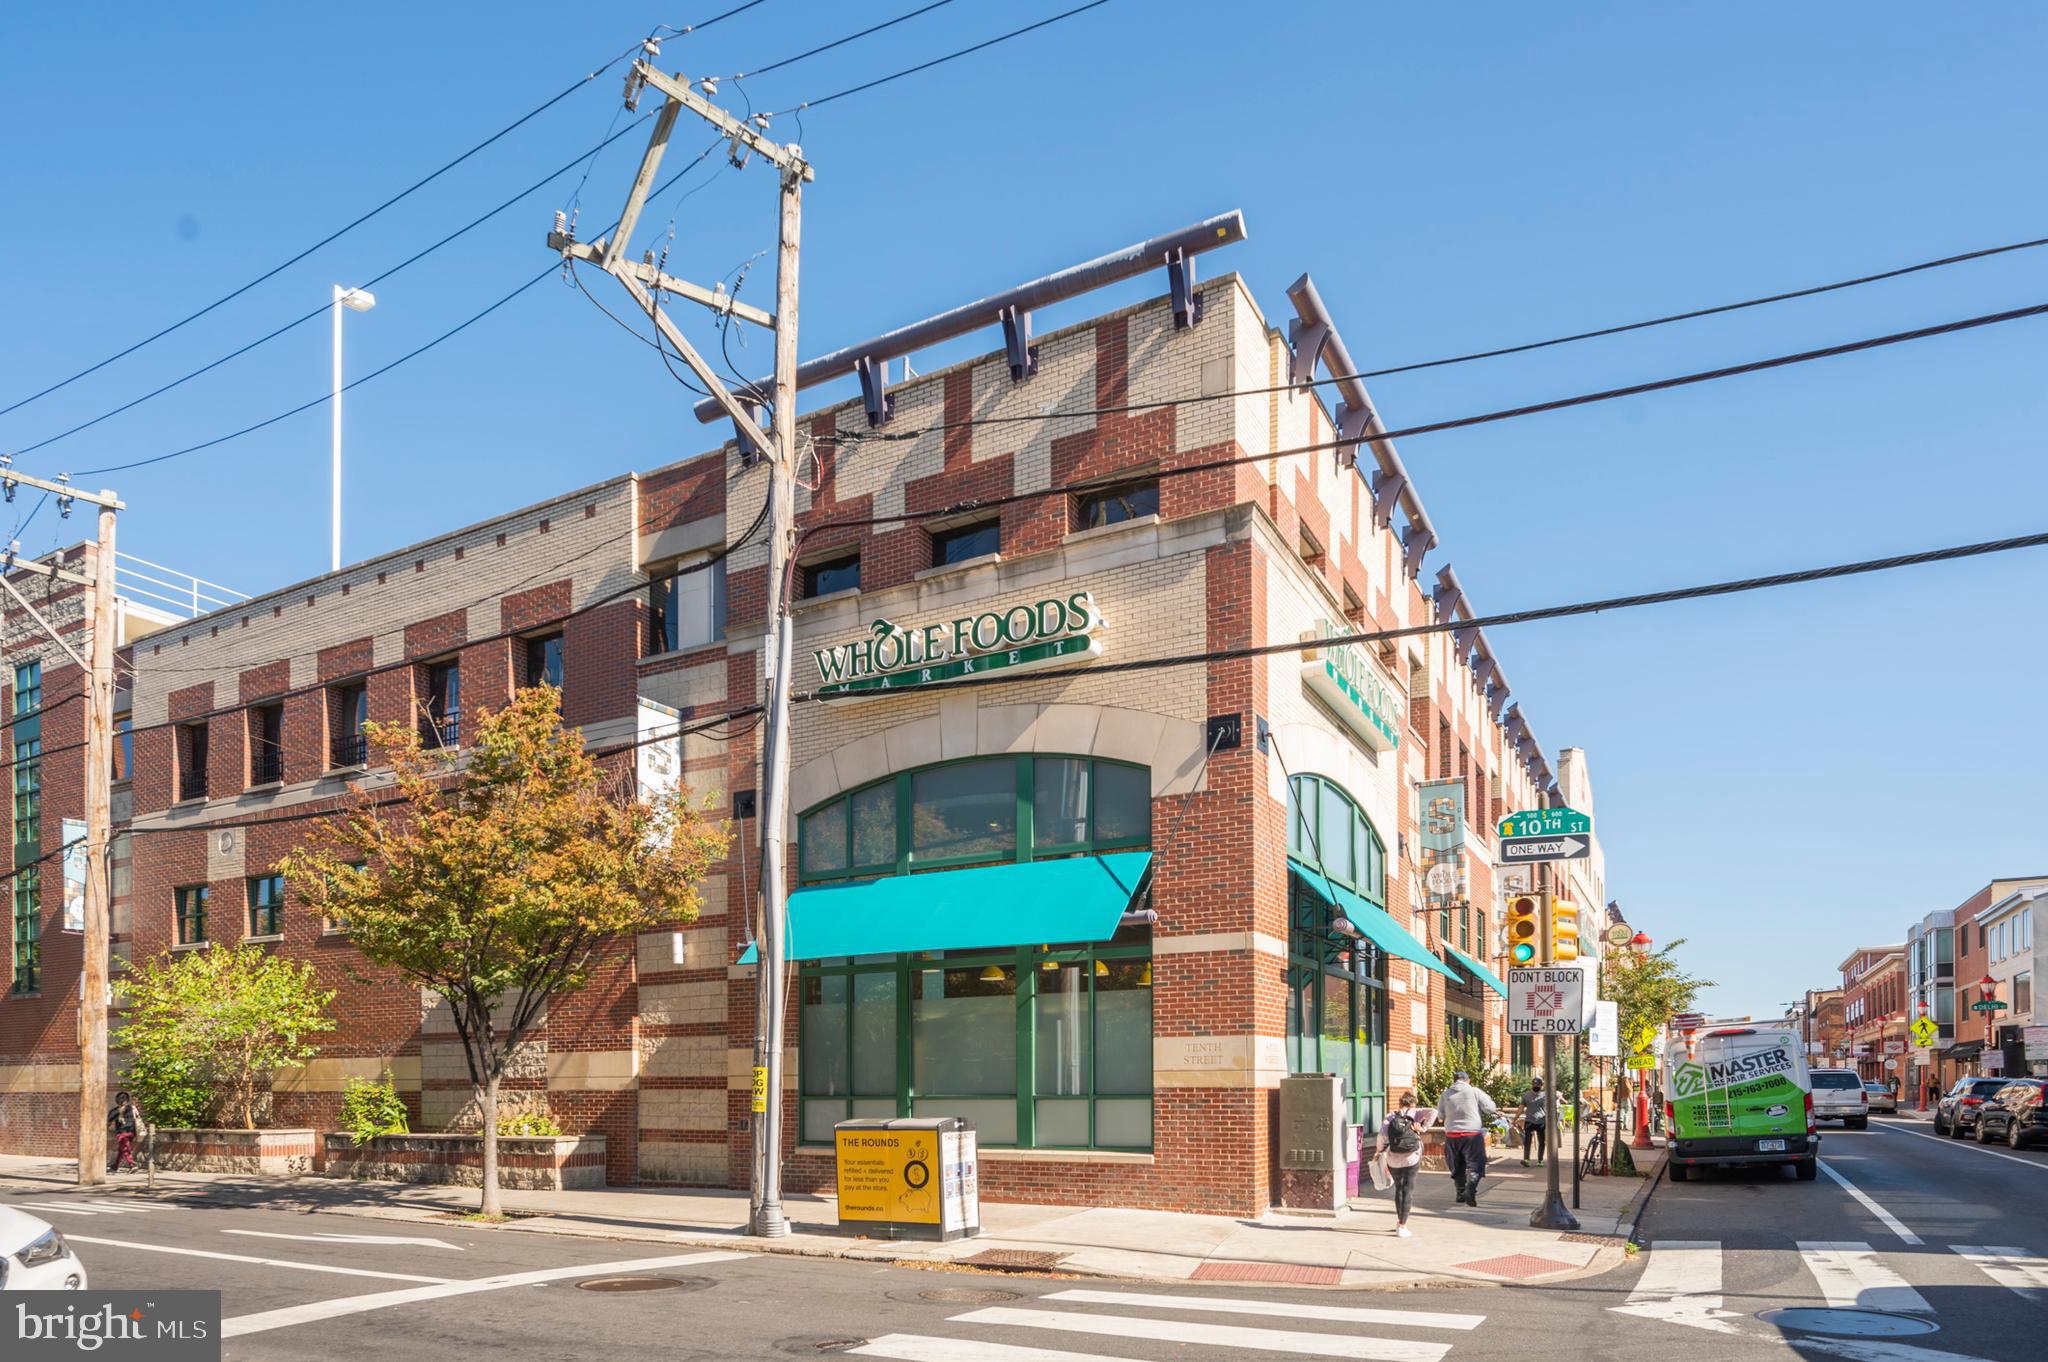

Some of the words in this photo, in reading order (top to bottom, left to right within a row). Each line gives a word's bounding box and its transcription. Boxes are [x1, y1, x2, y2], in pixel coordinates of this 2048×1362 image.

[812, 618, 949, 683] WHOLE
[951, 592, 1094, 656] FOODS
[1428, 798, 1455, 835] S
[1519, 818, 1562, 835] 10TH
[1570, 821, 1584, 833] ST
[1510, 845, 1534, 855] ONE
[1537, 843, 1563, 853] WAY
[1511, 971, 1541, 983] DONT
[1544, 971, 1579, 982] BLOCK
[1512, 1019, 1539, 1031] THE
[1546, 1019, 1576, 1031] BOX
[1185, 1043, 1222, 1053] TENTH
[1183, 1056, 1223, 1065] STREET
[1628, 1056, 1653, 1067] AHEAD
[1710, 1049, 1790, 1080] MASTER
[1713, 1073, 1746, 1087] REPAIR
[1748, 1061, 1792, 1079] SERVICES
[843, 1138, 859, 1147] THE
[861, 1138, 900, 1148] ROUNDS
